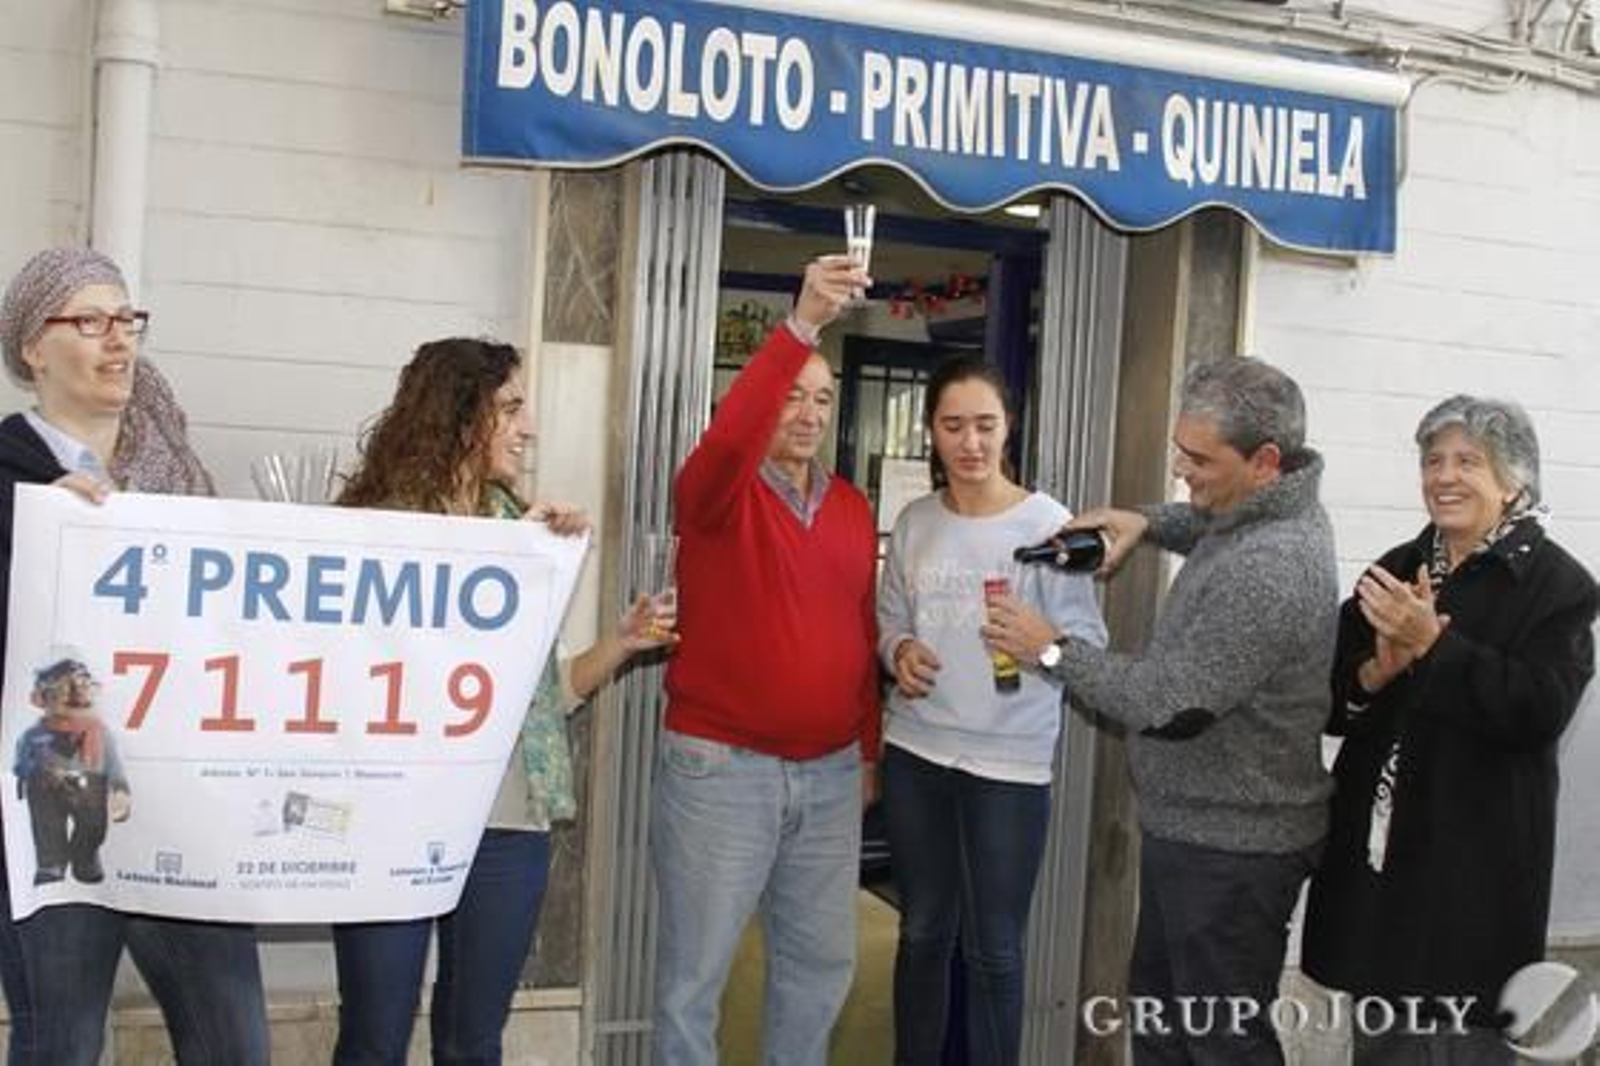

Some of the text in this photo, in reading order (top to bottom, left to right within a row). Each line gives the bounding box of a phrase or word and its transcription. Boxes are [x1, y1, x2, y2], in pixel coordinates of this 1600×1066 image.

[497, 0, 814, 131] BONOLOTO
[861, 51, 1120, 171] PRIMITIVA
[1161, 94, 1366, 199] QUINIELA
[186, 547, 520, 631] PREMIO
[112, 652, 495, 737] 71119
[258, 861, 277, 874] DE
